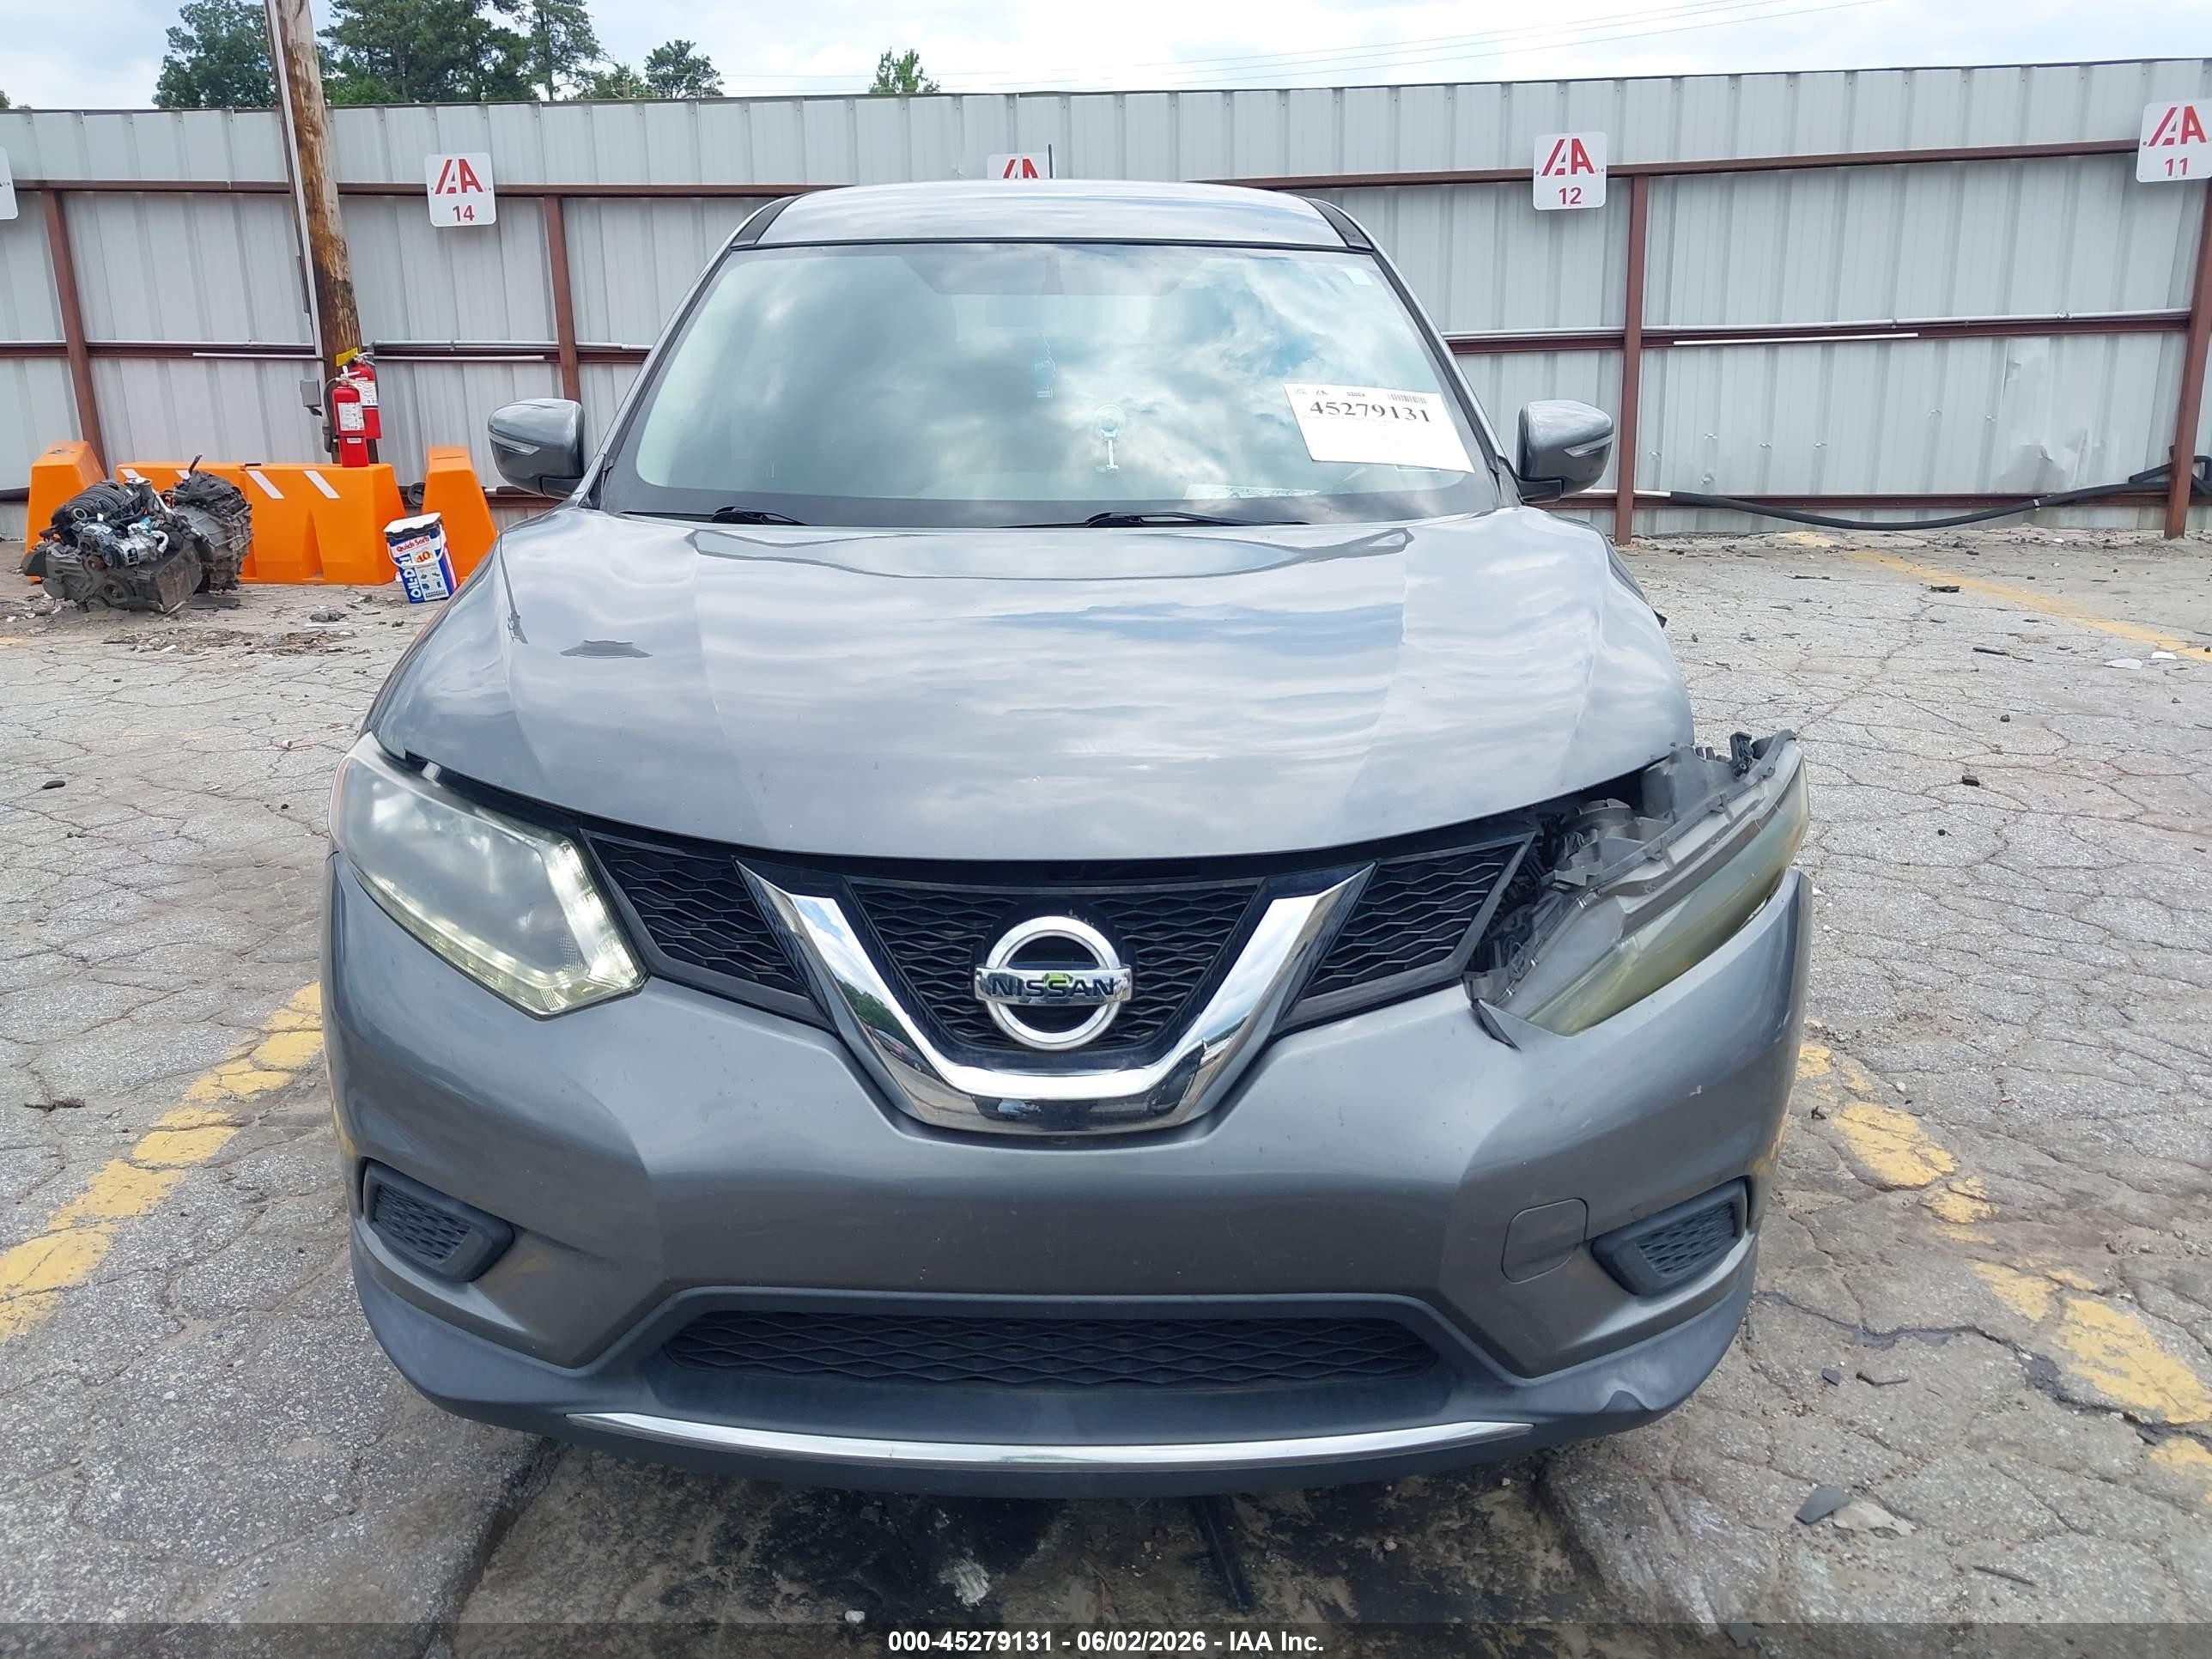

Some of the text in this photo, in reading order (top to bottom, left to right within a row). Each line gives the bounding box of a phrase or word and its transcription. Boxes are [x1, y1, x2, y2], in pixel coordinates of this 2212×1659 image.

[2165, 158, 2188, 176] 11
[1559, 187, 1582, 204] 12
[453, 205, 474, 222] 14
[1310, 401, 1431, 422] 45279131
[991, 976, 1115, 998] NISSAN
